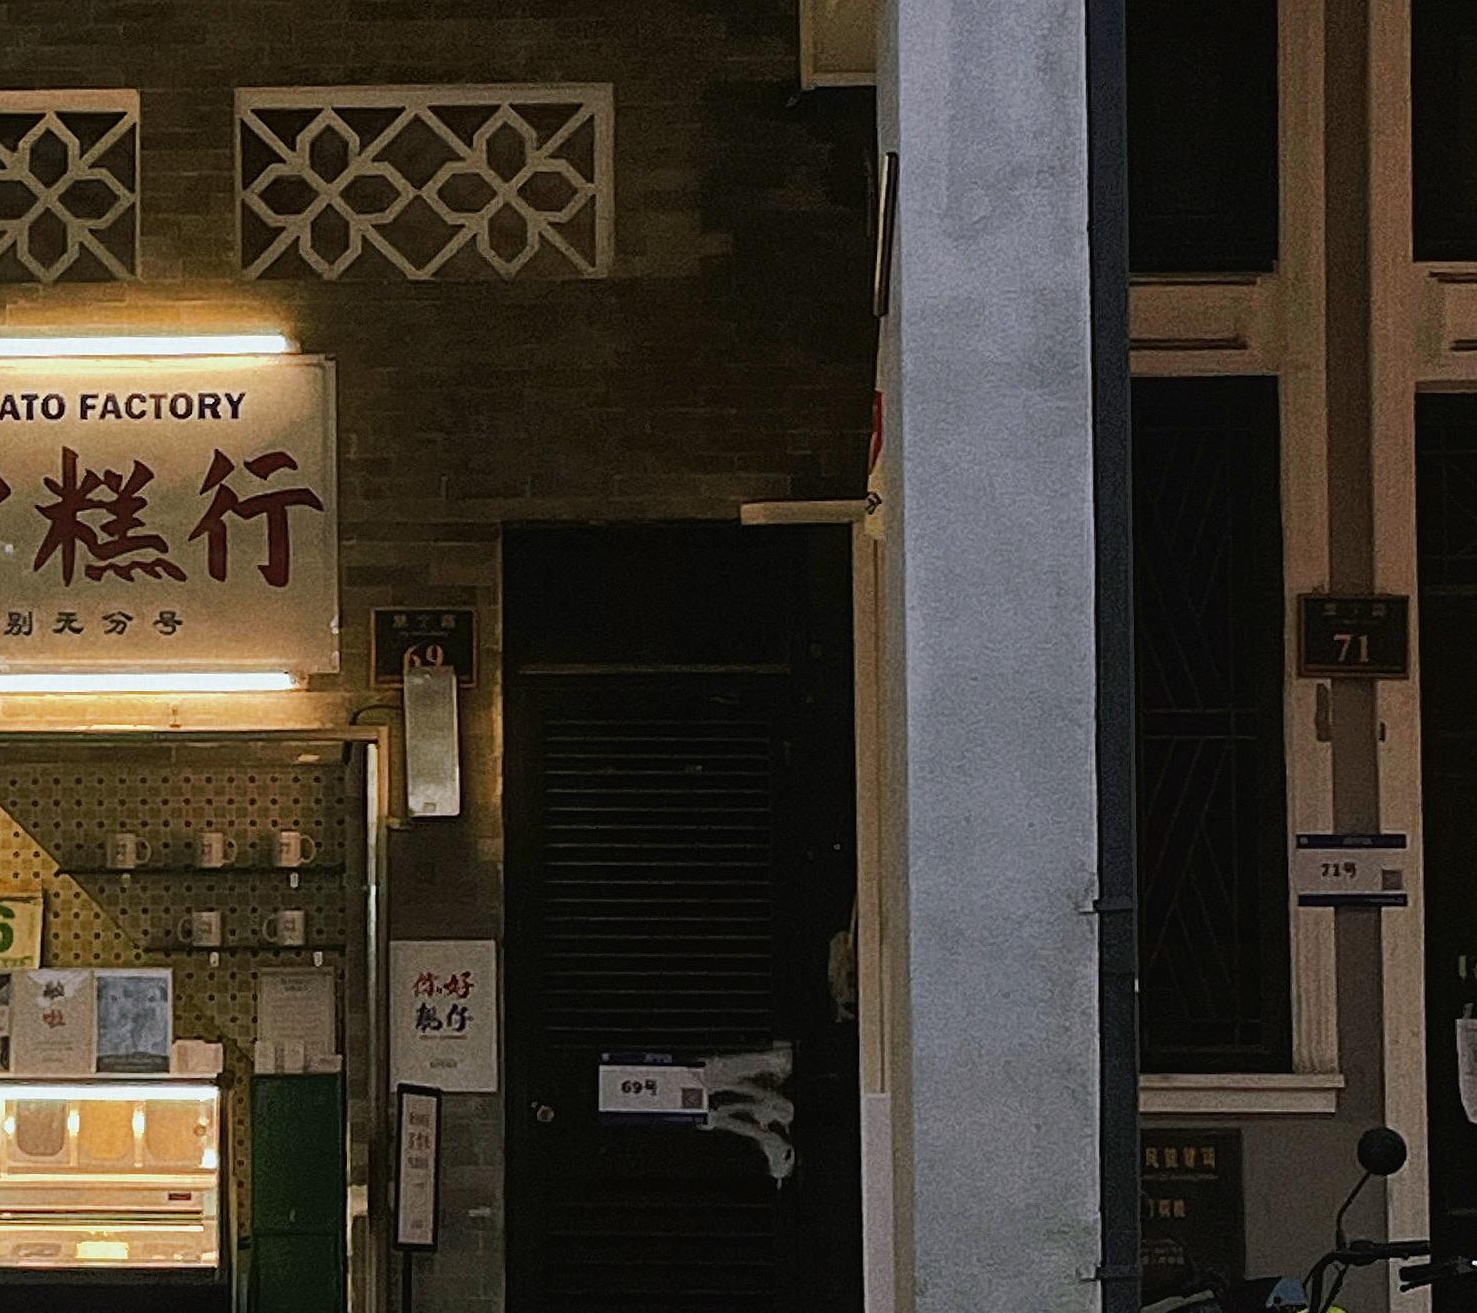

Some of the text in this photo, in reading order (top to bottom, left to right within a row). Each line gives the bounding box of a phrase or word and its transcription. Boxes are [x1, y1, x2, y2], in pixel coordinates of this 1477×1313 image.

[79, 392, 246, 420] FACTORY
[404, 644, 444, 667] 69
[1333, 633, 1371, 663] 71
[412, 971, 474, 998] 你好
[621, 1078, 657, 1097] 69号
